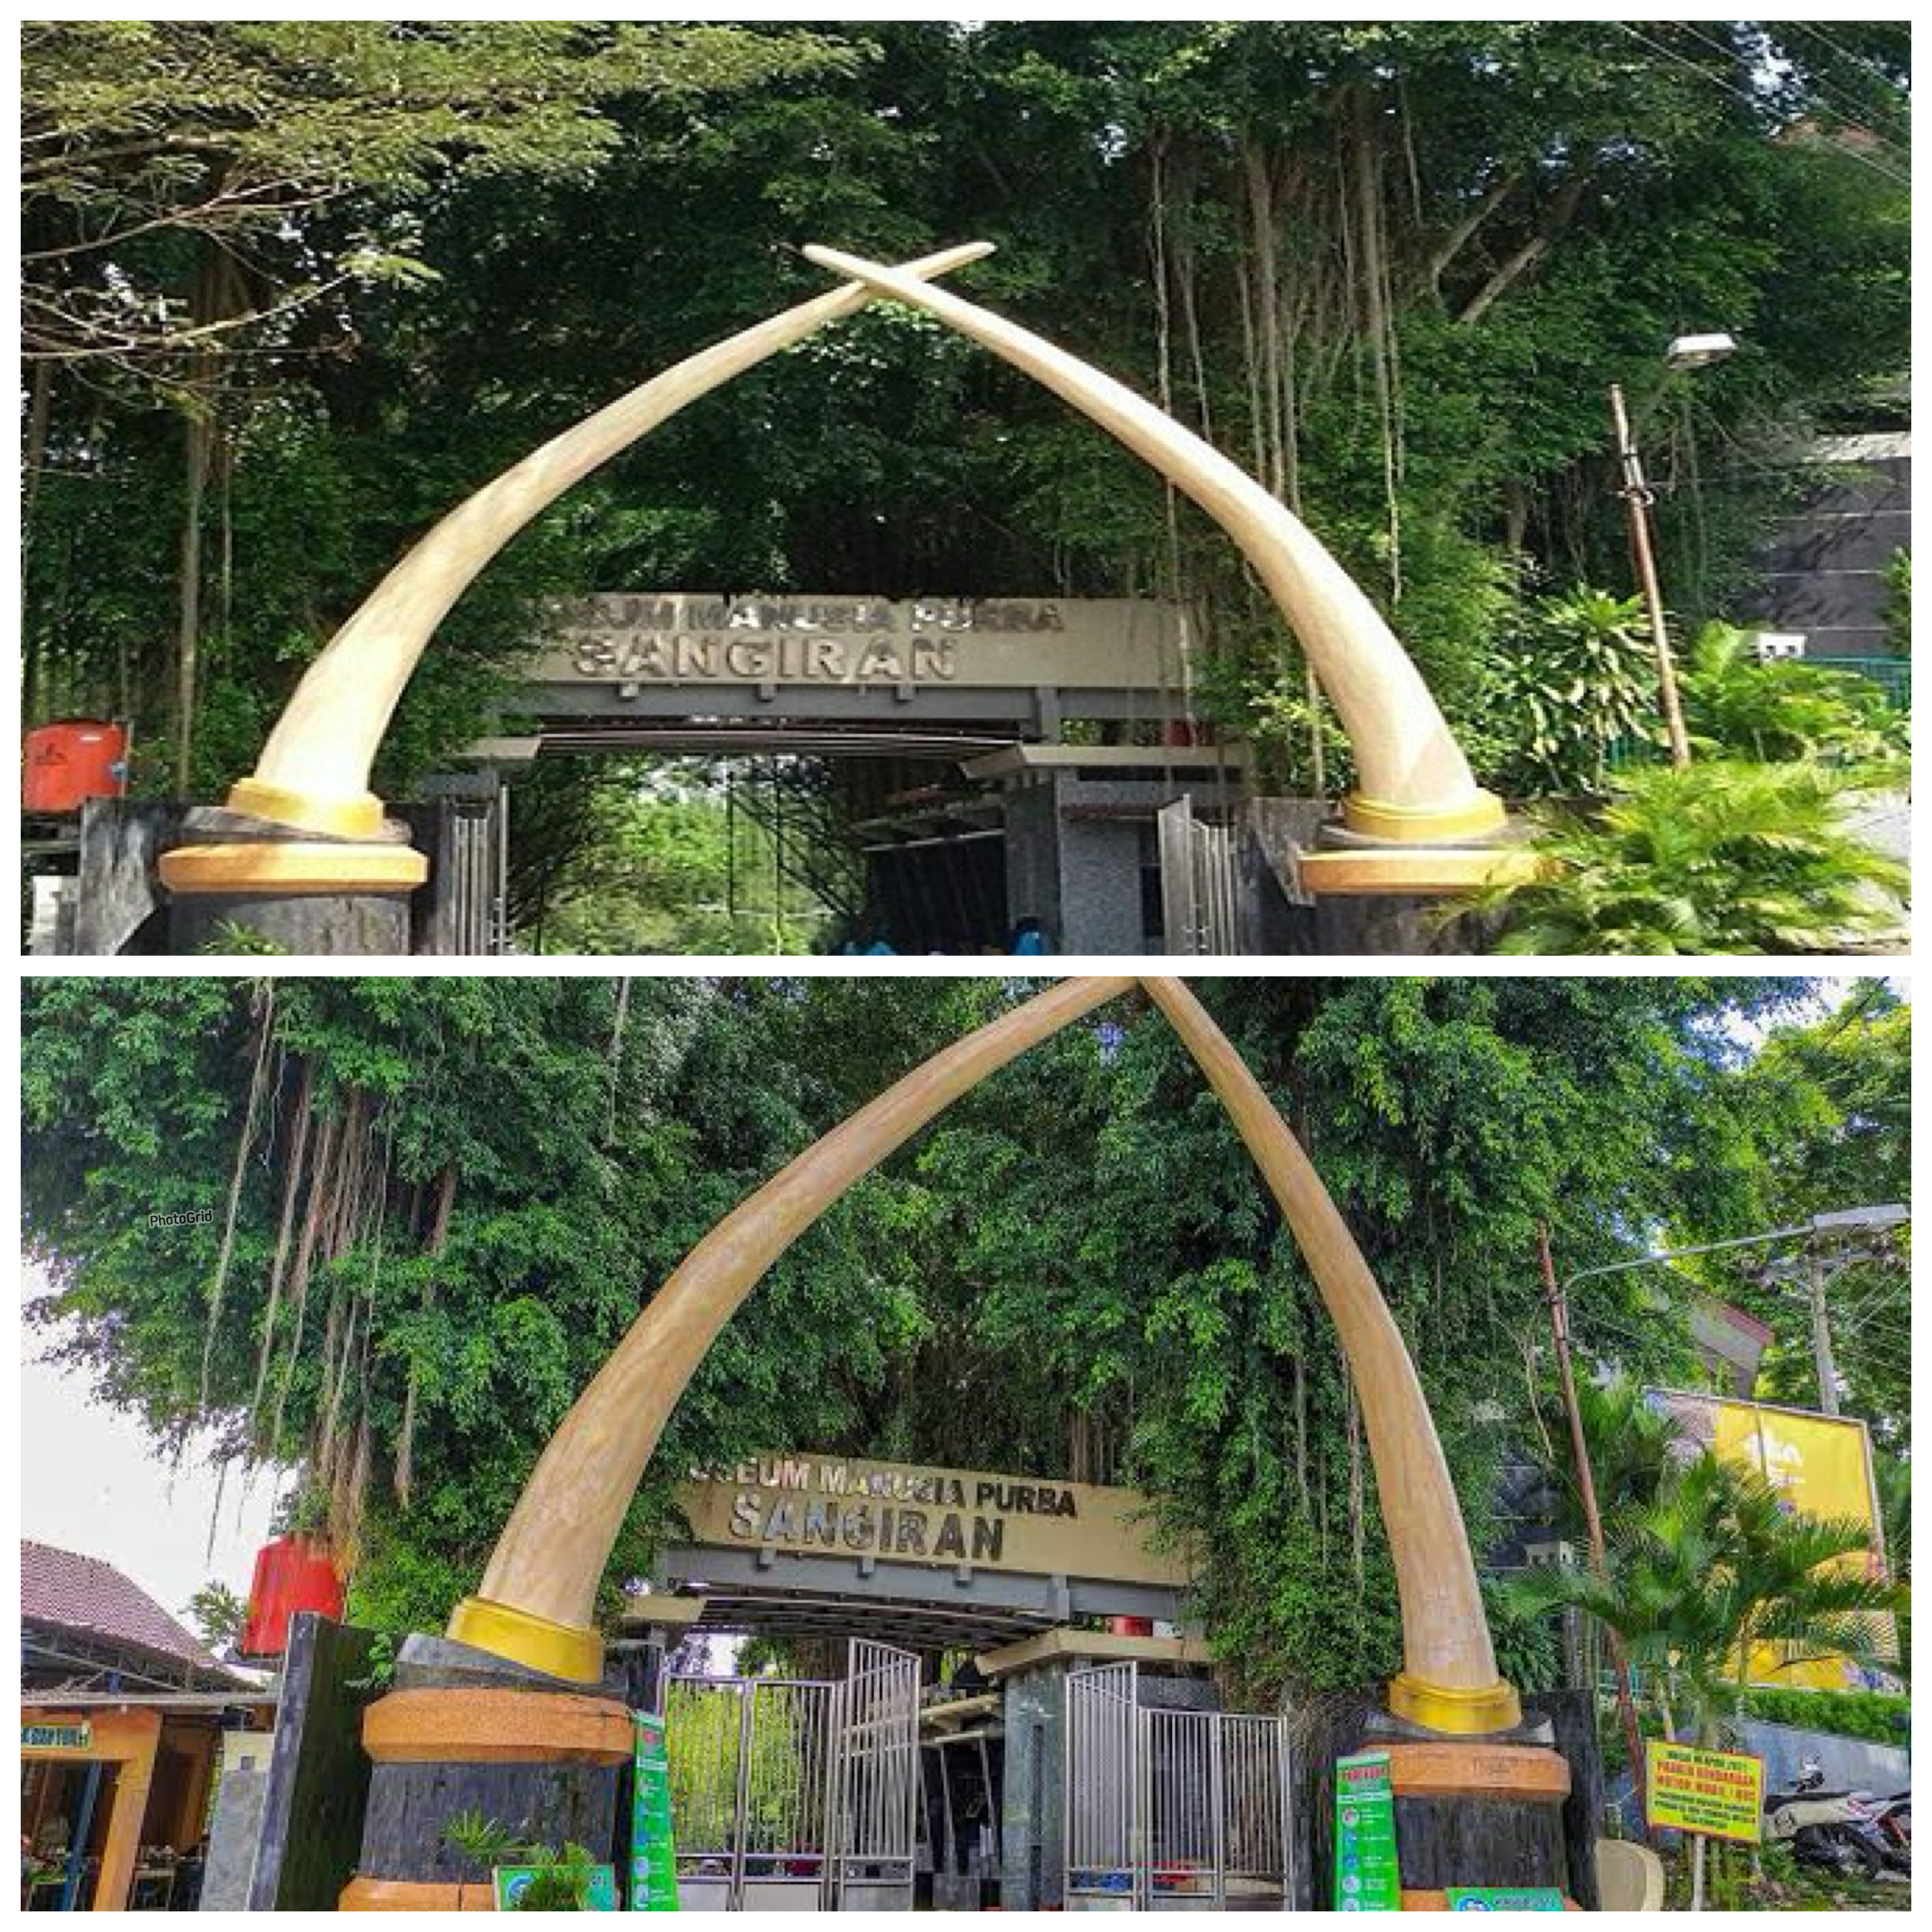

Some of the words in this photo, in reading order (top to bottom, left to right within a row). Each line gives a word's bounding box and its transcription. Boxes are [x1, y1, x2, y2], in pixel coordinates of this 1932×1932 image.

[572, 633, 957, 680] SANGIRAN
[820, 1465, 967, 1508] MANUSIA
[975, 1482, 1077, 1519] PURBA
[729, 1485, 1005, 1562] SANGIRAN
